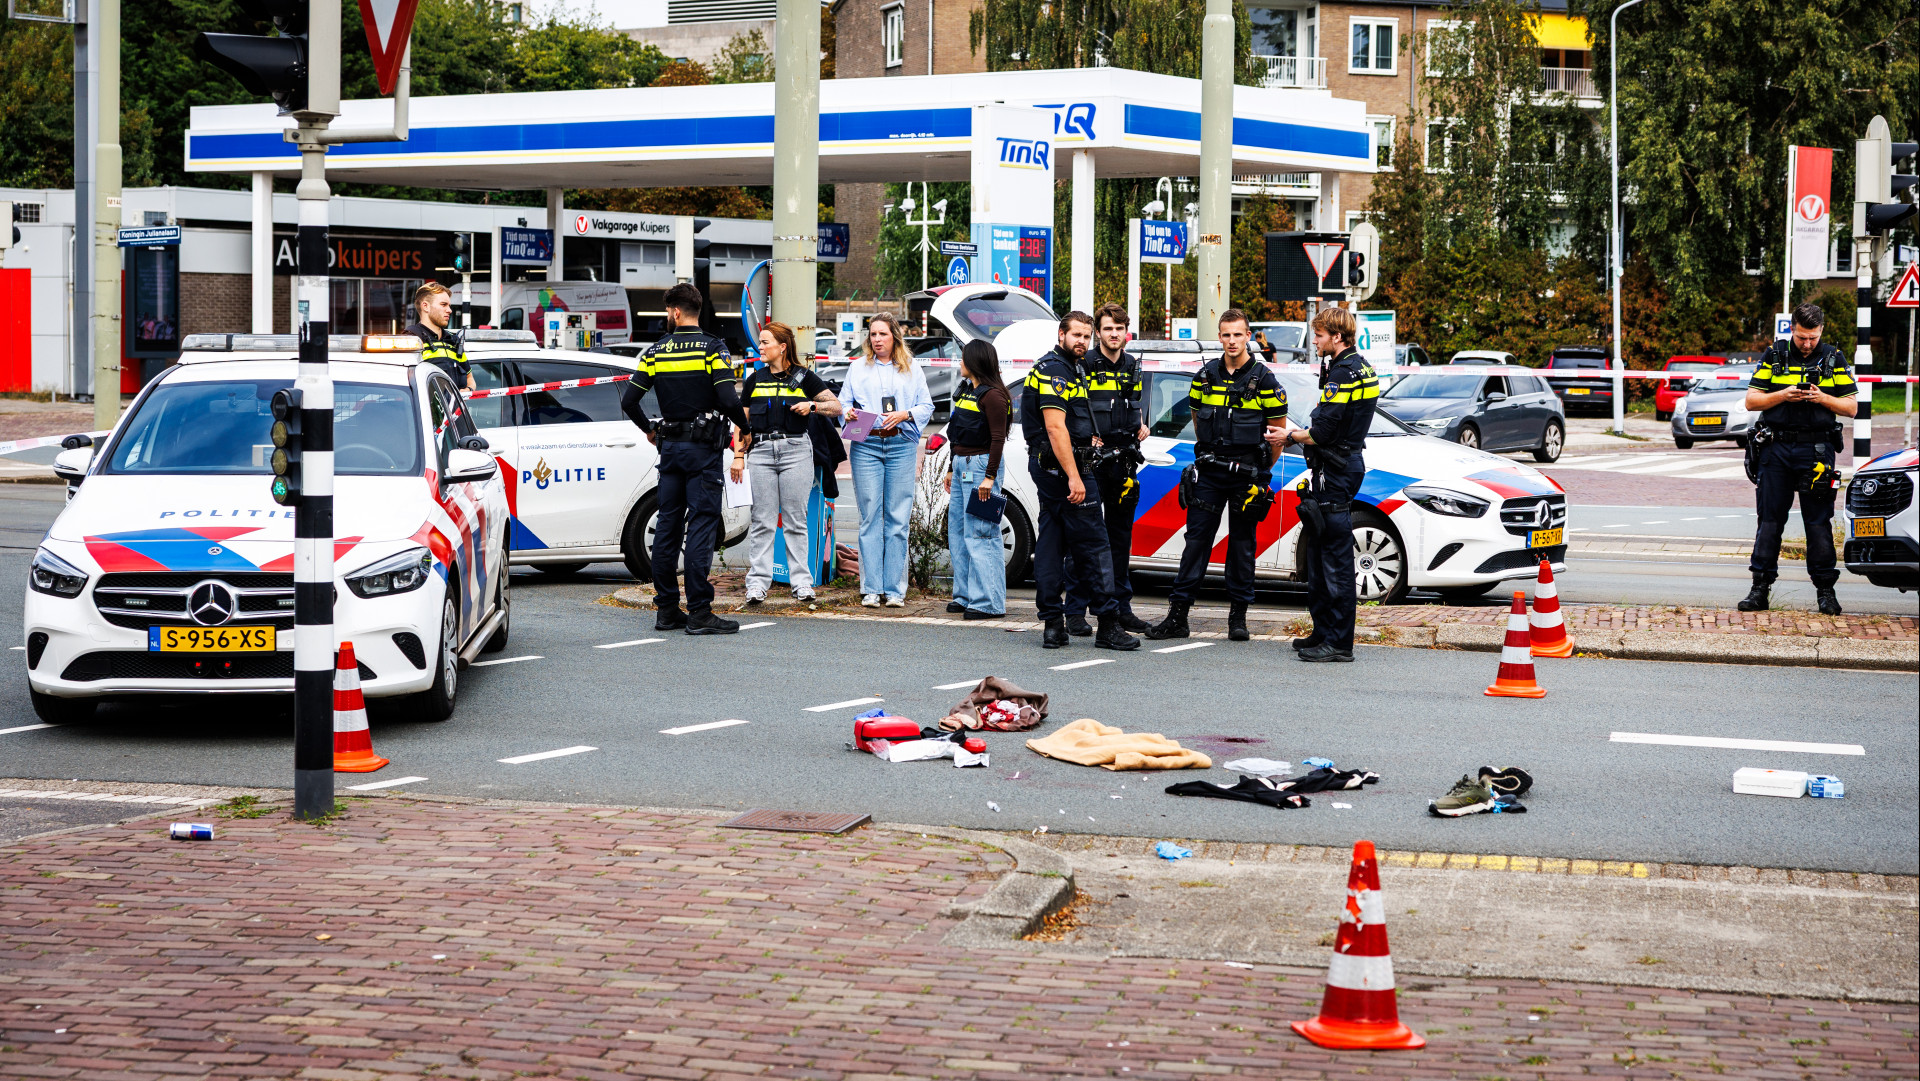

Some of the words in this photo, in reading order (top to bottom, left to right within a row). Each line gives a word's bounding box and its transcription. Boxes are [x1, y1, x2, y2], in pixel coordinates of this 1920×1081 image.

[996, 137, 1049, 170] TinQ
[592, 218, 638, 234] Vakgarage
[640, 221, 670, 234] Kuipers
[1144, 225, 1155, 236] Tijd
[1156, 227, 1165, 236] om
[1165, 226, 1171, 237] te
[121, 231, 145, 239] Koningin
[146, 229, 177, 237] Julianalaan
[505, 231, 519, 241] Tijd
[520, 233, 528, 241] om
[529, 233, 536, 242] te
[826, 228, 832, 237] te
[993, 229, 1001, 238] Tijd
[1002, 230, 1008, 238] om
[505, 242, 536, 257] TinQ'en
[818, 239, 832, 253] Q'en
[993, 238, 1018, 251] tanken!
[1145, 237, 1171, 254] TinQ'en
[1780, 321, 1789, 332] P
[1371, 333, 1390, 342] DEKKER
[661, 341, 701, 352] POLITIE
[523, 467, 606, 489] POLITIE
[159, 510, 295, 518] POLITIE
[167, 630, 266, 648] S-956-XS
